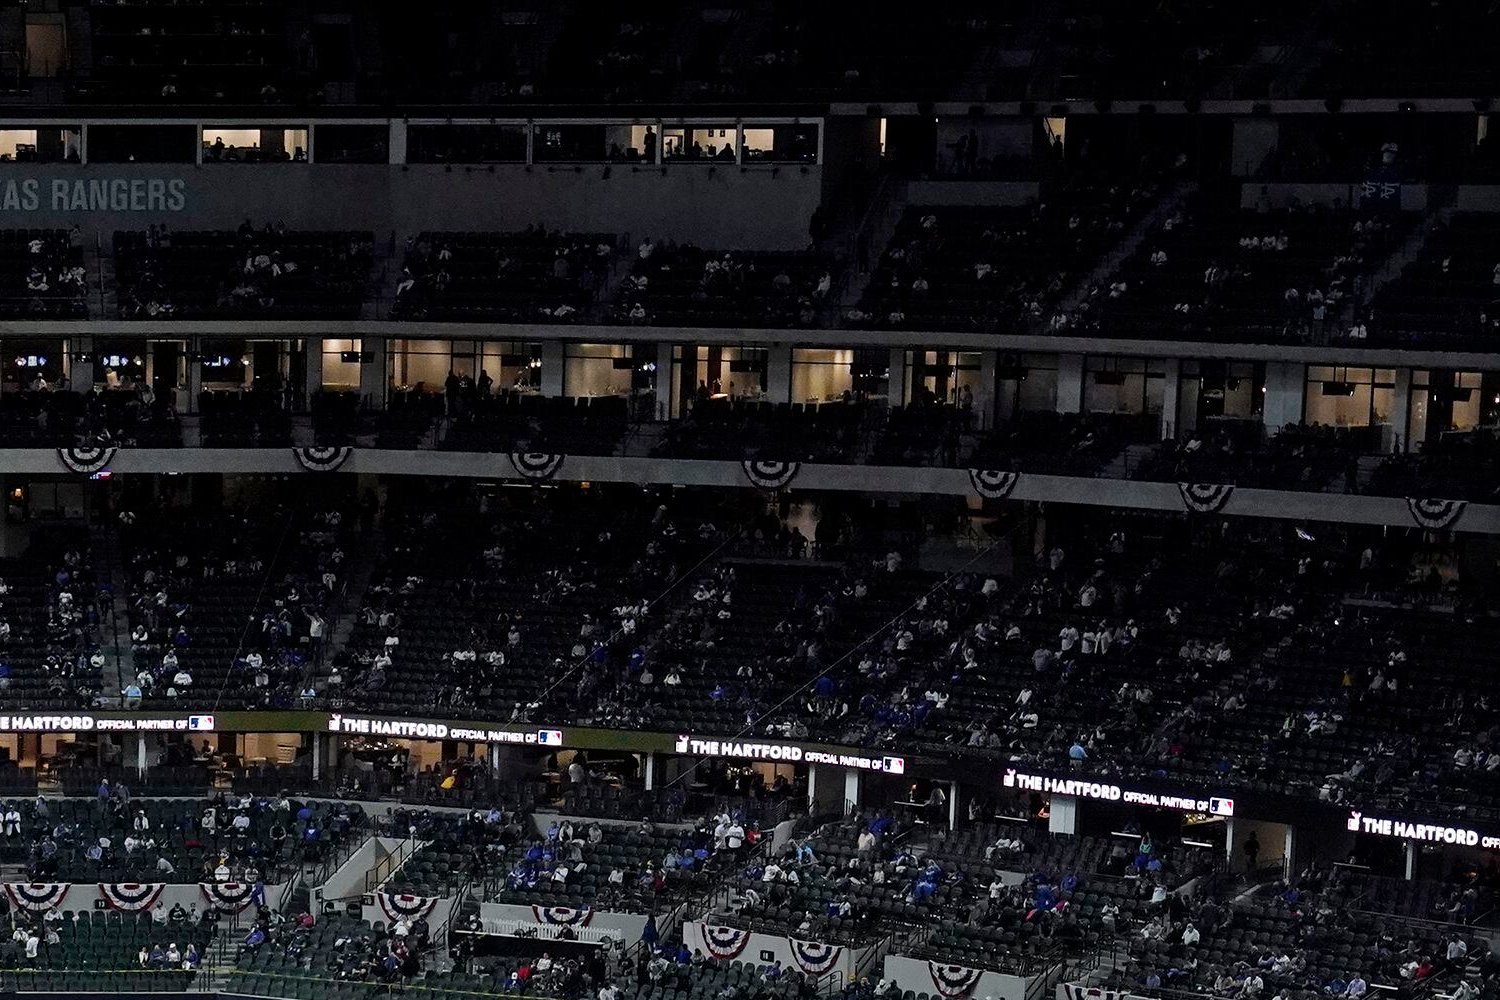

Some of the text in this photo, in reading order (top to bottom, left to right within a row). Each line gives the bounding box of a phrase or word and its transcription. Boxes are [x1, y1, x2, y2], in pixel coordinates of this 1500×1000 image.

[51, 179, 185, 211] RANGERS
[12, 716, 94, 729] HARTFORD
[96, 720, 135, 729] OFFICIAL
[137, 720, 173, 729] PARTNER
[176, 720, 188, 729] OF
[342, 719, 537, 743] THE HARTFORD OFFICIAL PARTNER OF
[690, 740, 882, 769] THE HARTFORD OFFICIAL PARTNER OF
[1017, 774, 1209, 811] THE HARTFORD OFFICIAL PARTNER OF
[1363, 817, 1391, 835] THE
[1394, 822, 1478, 847] HARTFORD
